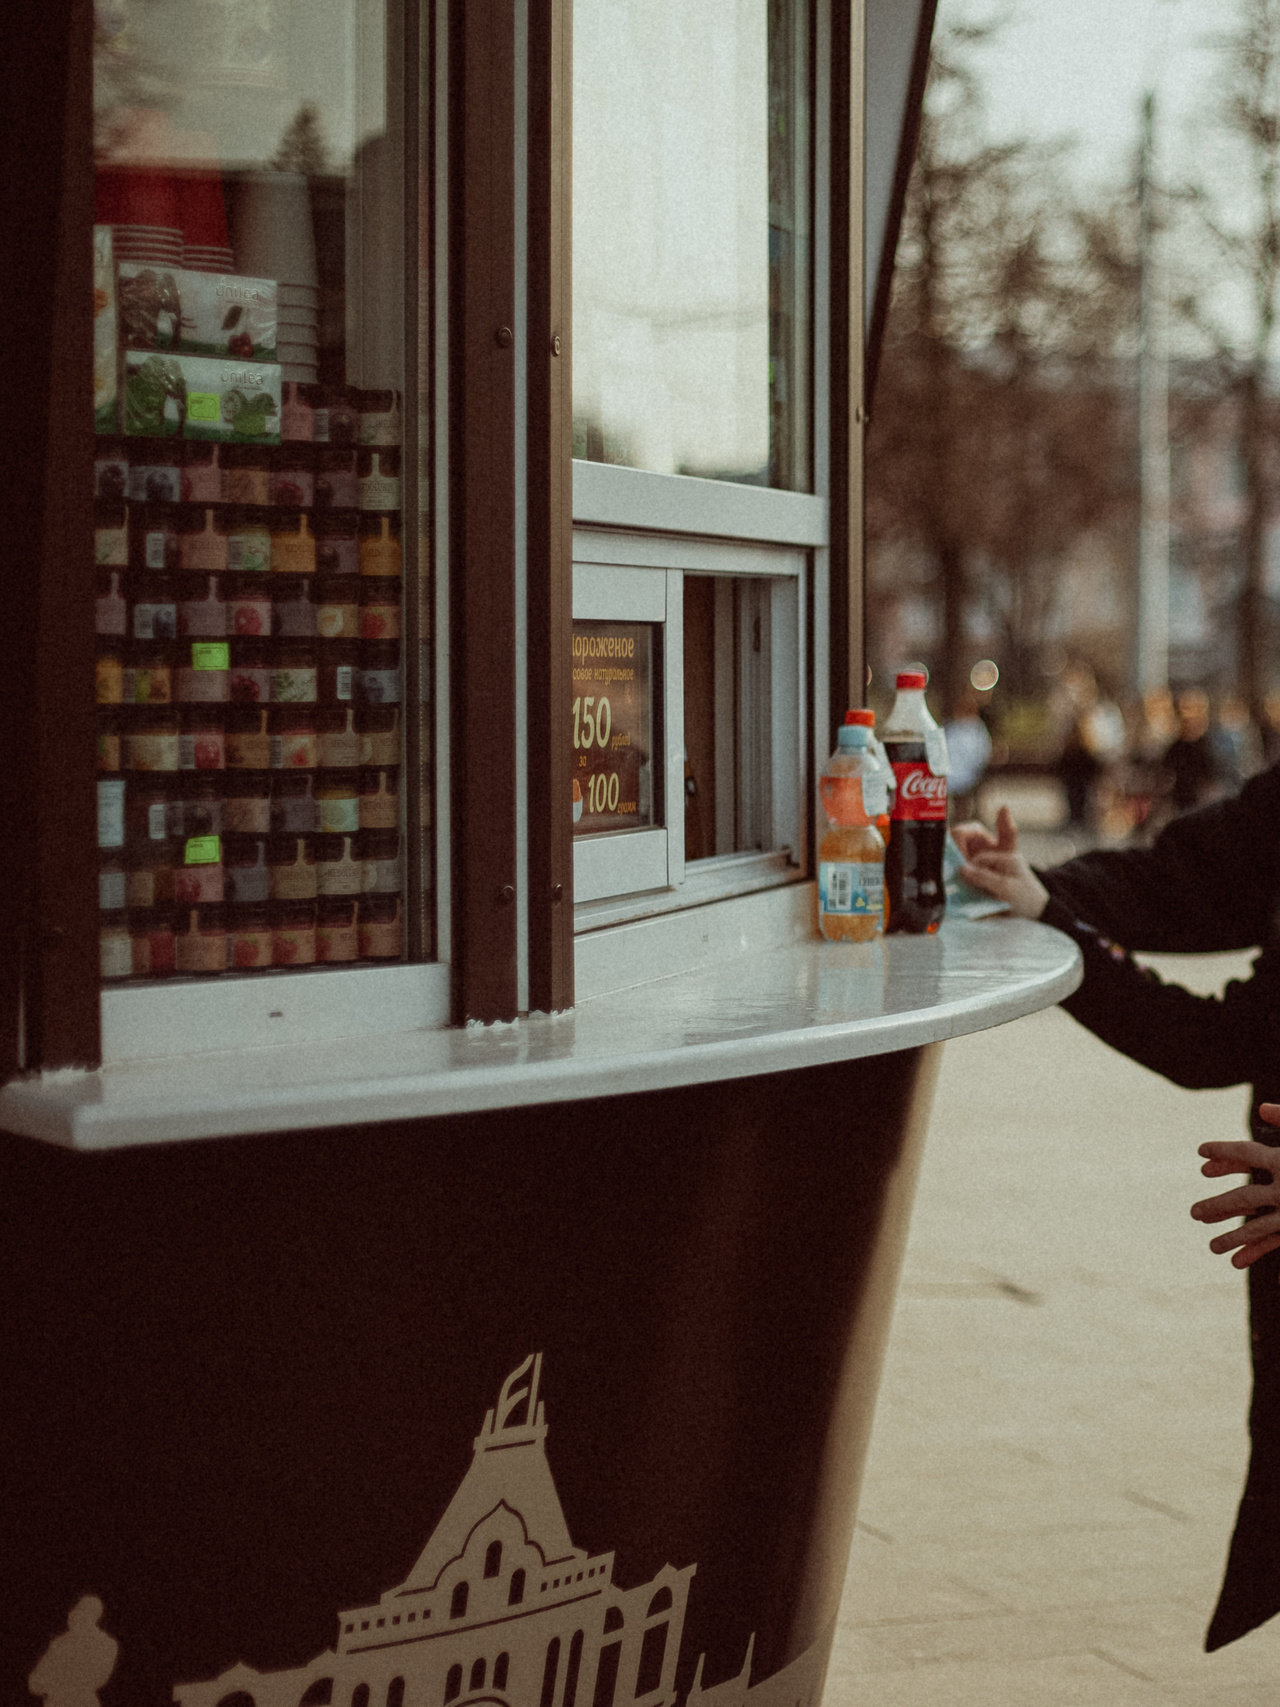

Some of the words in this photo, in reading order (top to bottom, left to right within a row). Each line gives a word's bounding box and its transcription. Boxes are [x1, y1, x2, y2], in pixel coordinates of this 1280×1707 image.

[572, 633, 634, 665] ороженое
[594, 668, 634, 685] натуральное
[572, 697, 611, 749] 150
[579, 756, 586, 767] за
[588, 773, 619, 813] 100
